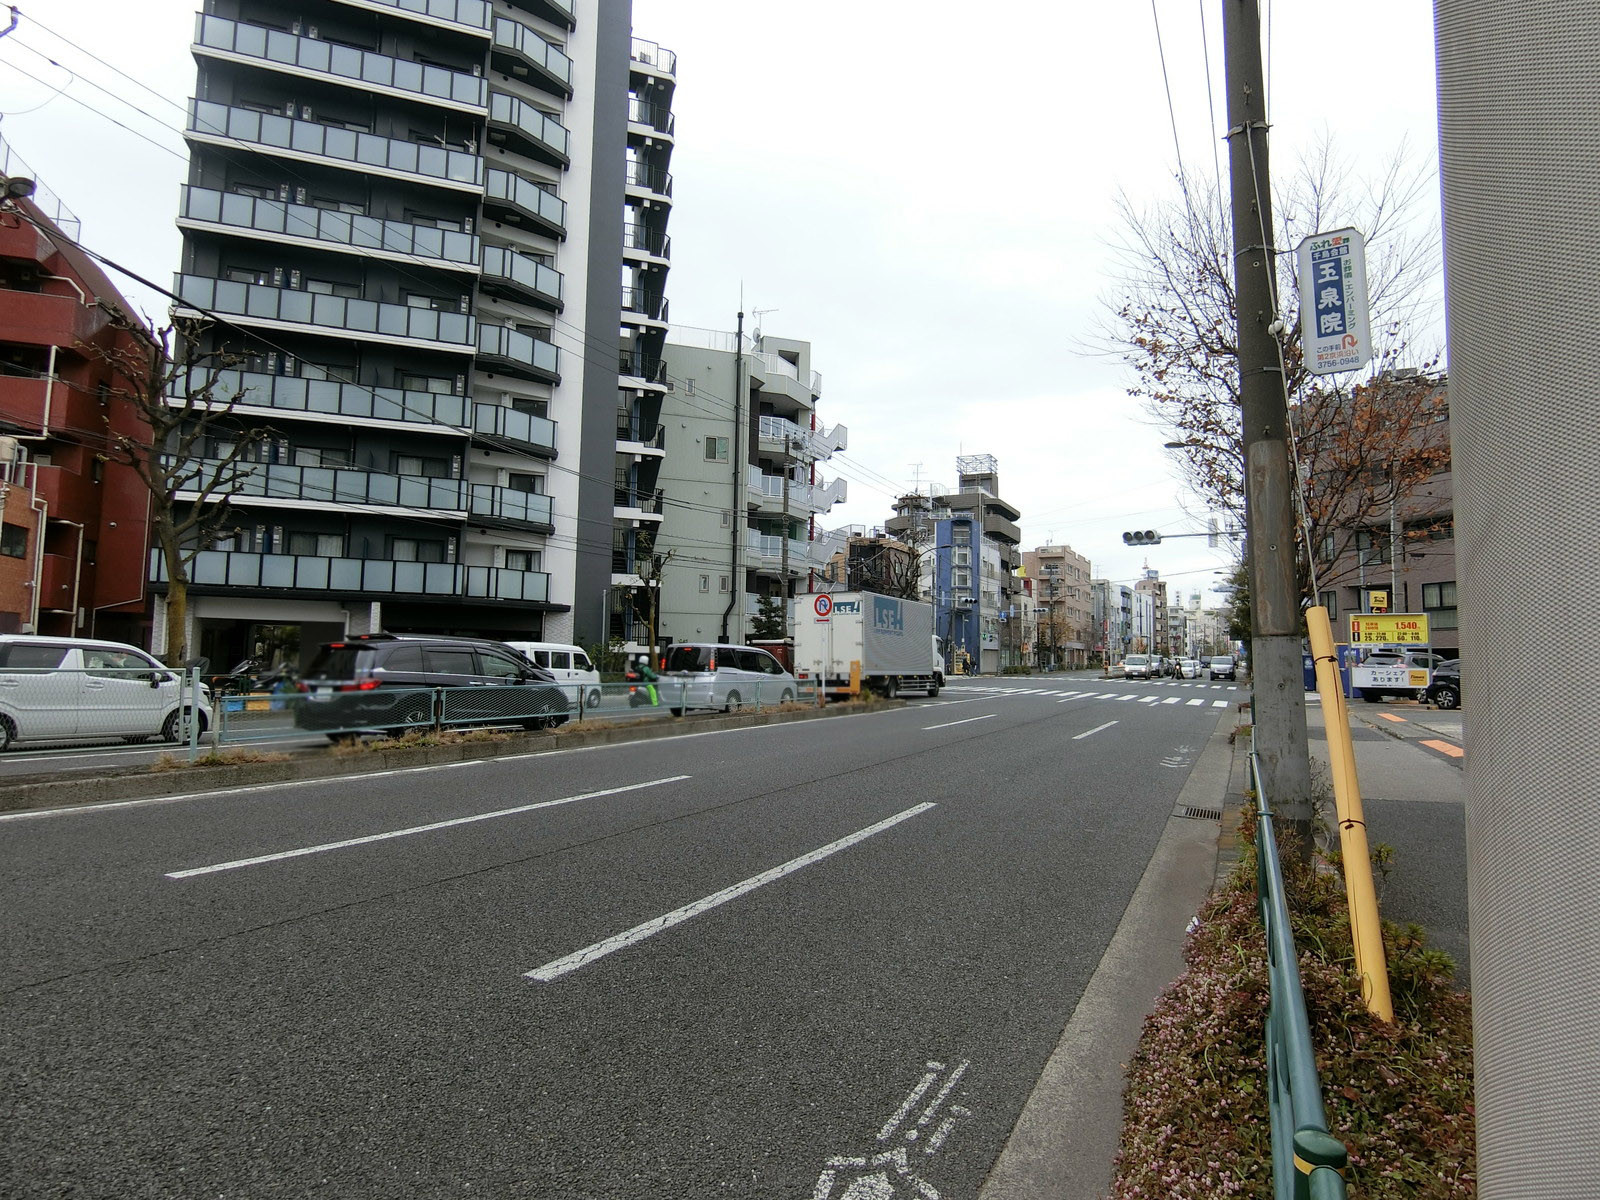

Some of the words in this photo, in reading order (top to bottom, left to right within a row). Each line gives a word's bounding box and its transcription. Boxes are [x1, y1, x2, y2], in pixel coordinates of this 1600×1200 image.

[1317, 262, 1344, 334] 玉泉院
[1316, 344, 1341, 353] この手前
[1317, 356, 1360, 369] 3756-0948
[1395, 622, 1420, 630] 1,540
